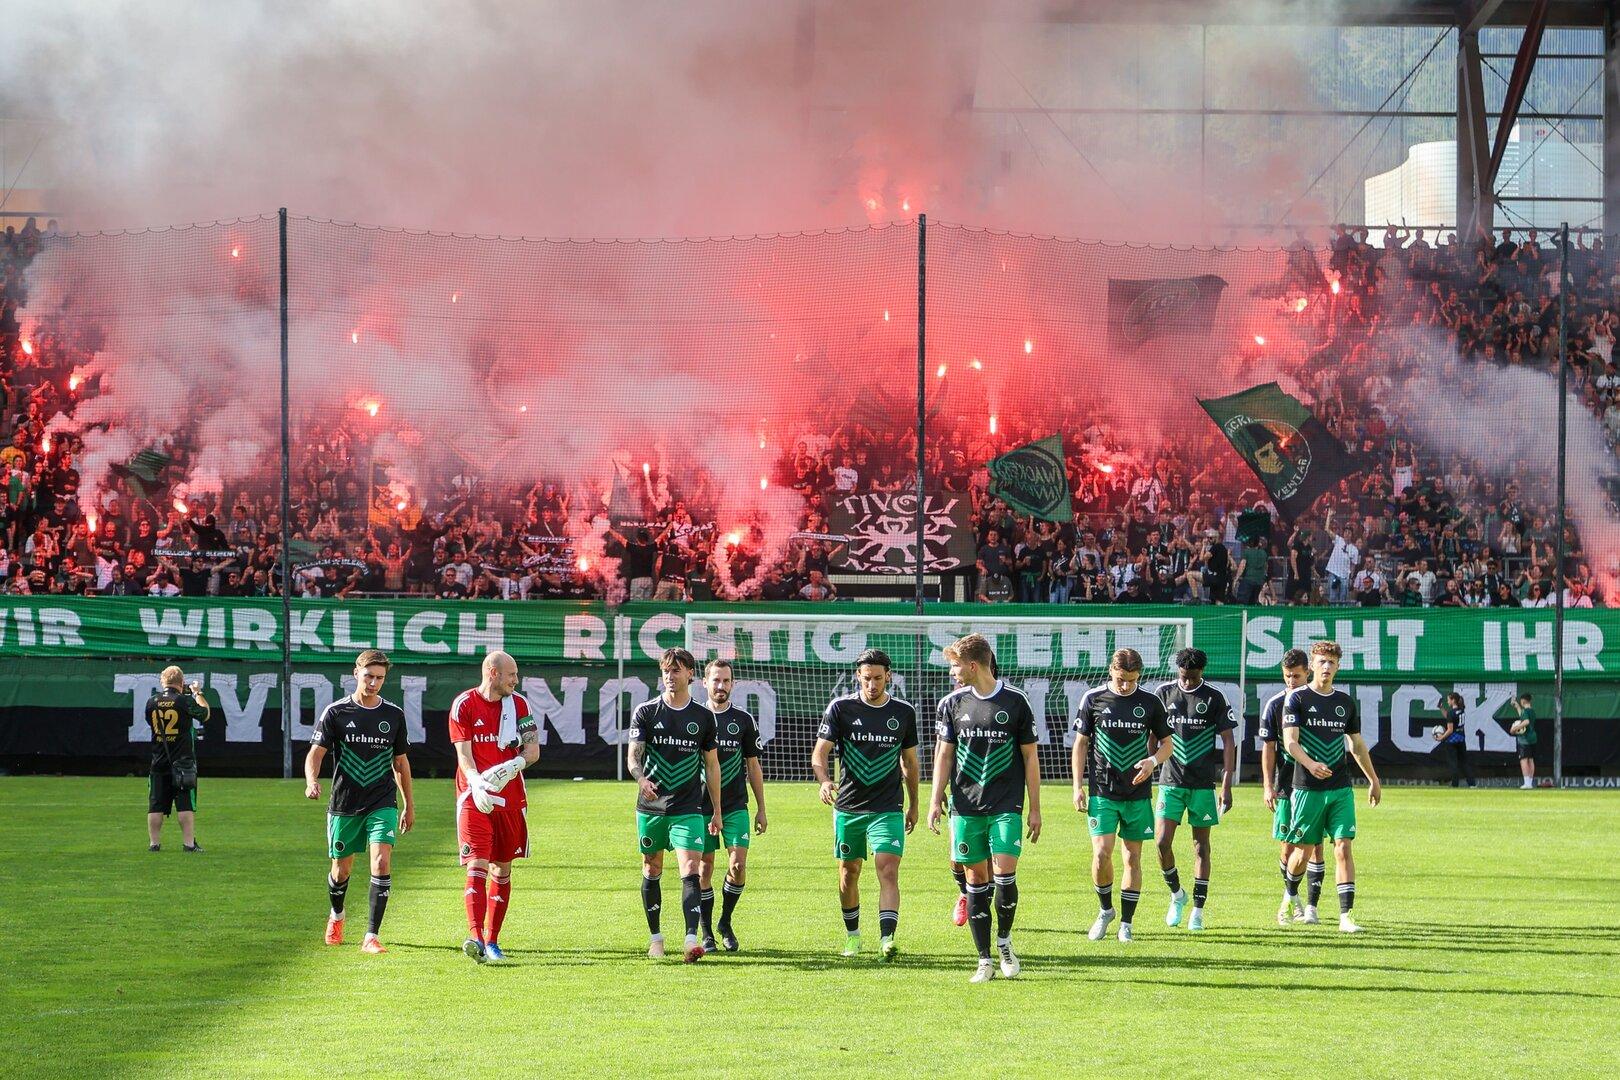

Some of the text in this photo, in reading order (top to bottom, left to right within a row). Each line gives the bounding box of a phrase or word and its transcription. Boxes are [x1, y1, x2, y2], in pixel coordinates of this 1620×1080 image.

[836, 493, 959, 515] TIVOLI
[0, 607, 85, 647] IR
[139, 607, 505, 656] WIRKLICH
[563, 613, 868, 664] RICHTIG
[1483, 620, 1605, 672] IHR
[1100, 719, 1145, 729] Aichner
[1171, 714, 1207, 725] ichner
[344, 734, 390, 743] Aichner
[850, 731, 898, 743] Aichner
[958, 728, 1008, 738] Aichner
[652, 735, 698, 747] Aichner
